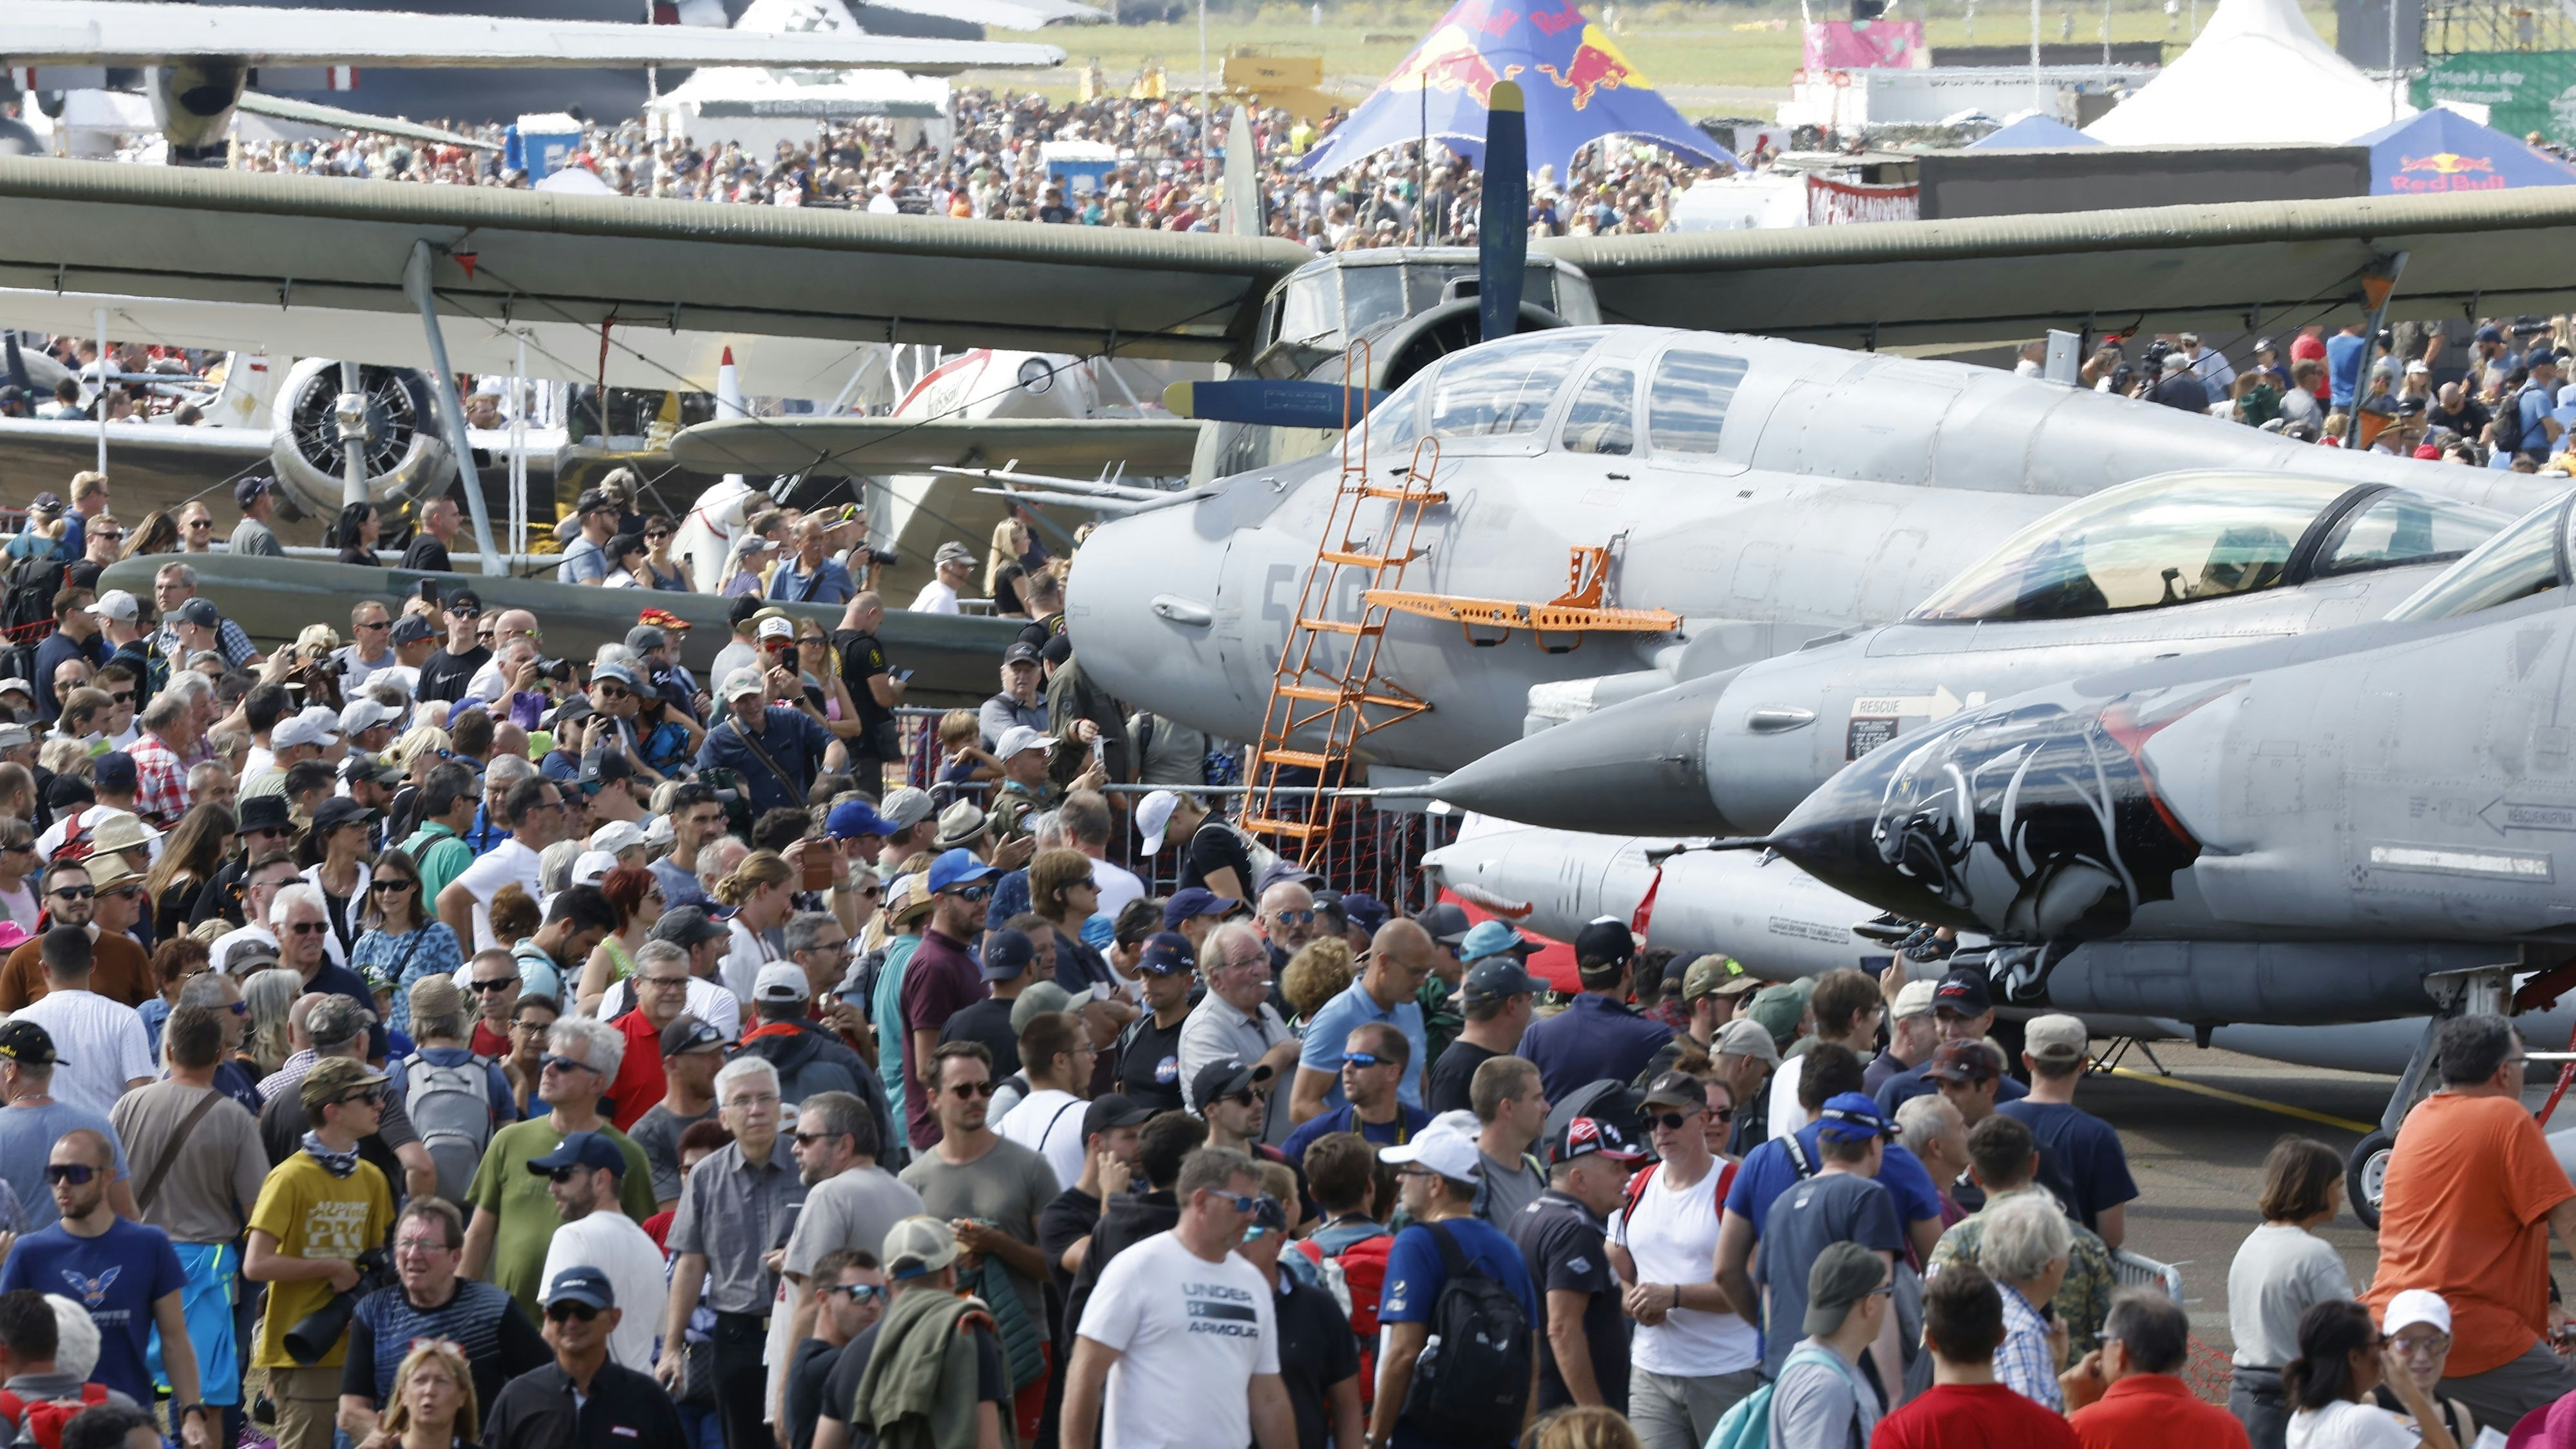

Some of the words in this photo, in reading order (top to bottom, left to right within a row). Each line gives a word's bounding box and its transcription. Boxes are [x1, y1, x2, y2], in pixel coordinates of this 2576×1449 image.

[1529, 0, 1585, 37] Red
[2391, 174, 2447, 193] Red
[2452, 174, 2505, 192] Bull
[1860, 700, 1900, 712] RESCUE
[1181, 1282, 1253, 1302] UNDER
[1188, 1321, 1259, 1340] ARMOUR
